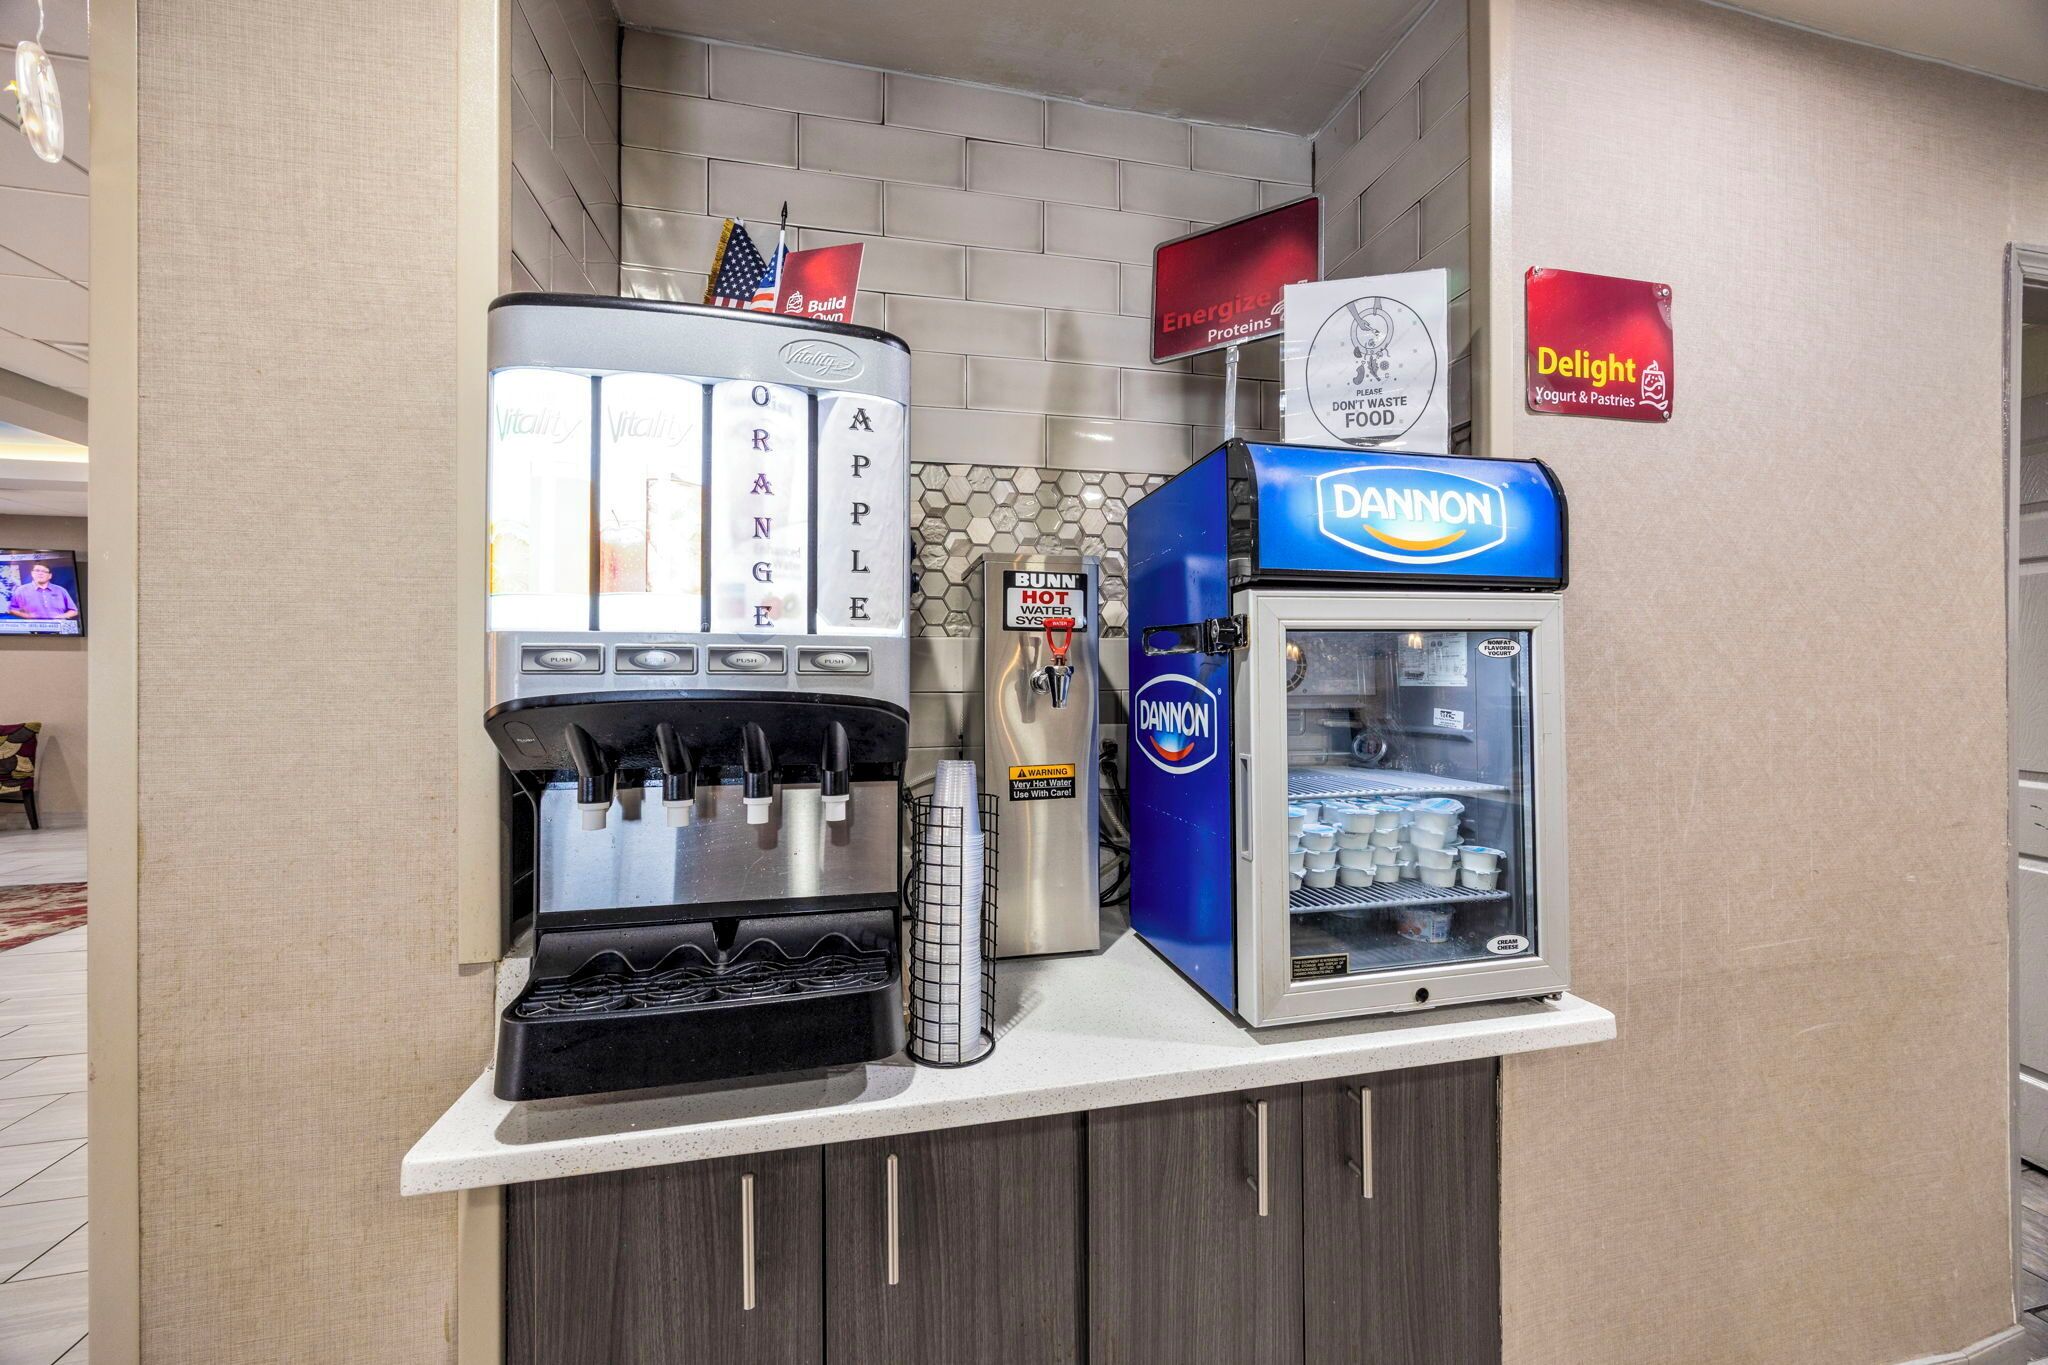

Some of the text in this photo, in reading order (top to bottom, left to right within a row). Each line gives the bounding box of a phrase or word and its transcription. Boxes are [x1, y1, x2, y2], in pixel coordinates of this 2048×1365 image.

[808, 296, 847, 313] Build
[1162, 290, 1272, 333] Energize
[815, 312, 844, 322] Own
[1208, 317, 1272, 342] Proteins
[785, 344, 838, 376] Vitality
[1538, 346, 1636, 388] Delight
[1356, 388, 1383, 396] PLEASE
[1536, 387, 1635, 407] Yogurt & Pastries
[1332, 396, 1408, 411] DON'T WASTE
[496, 404, 583, 444] Vitality
[607, 405, 694, 447] Vitality
[1345, 410, 1395, 428] FOOD
[750, 385, 775, 628] ORANGE
[1333, 483, 1493, 525] DANNON
[849, 407, 875, 621] APPLE
[1015, 572, 1076, 588] BUNN
[1022, 590, 1069, 605] HOT
[1020, 605, 1072, 615] WATER
[1140, 699, 1209, 738] DANNON
[1027, 768, 1068, 777] WARNING
[1013, 779, 1072, 789] Very Hot Water
[1013, 788, 1072, 799] Use With Care!
